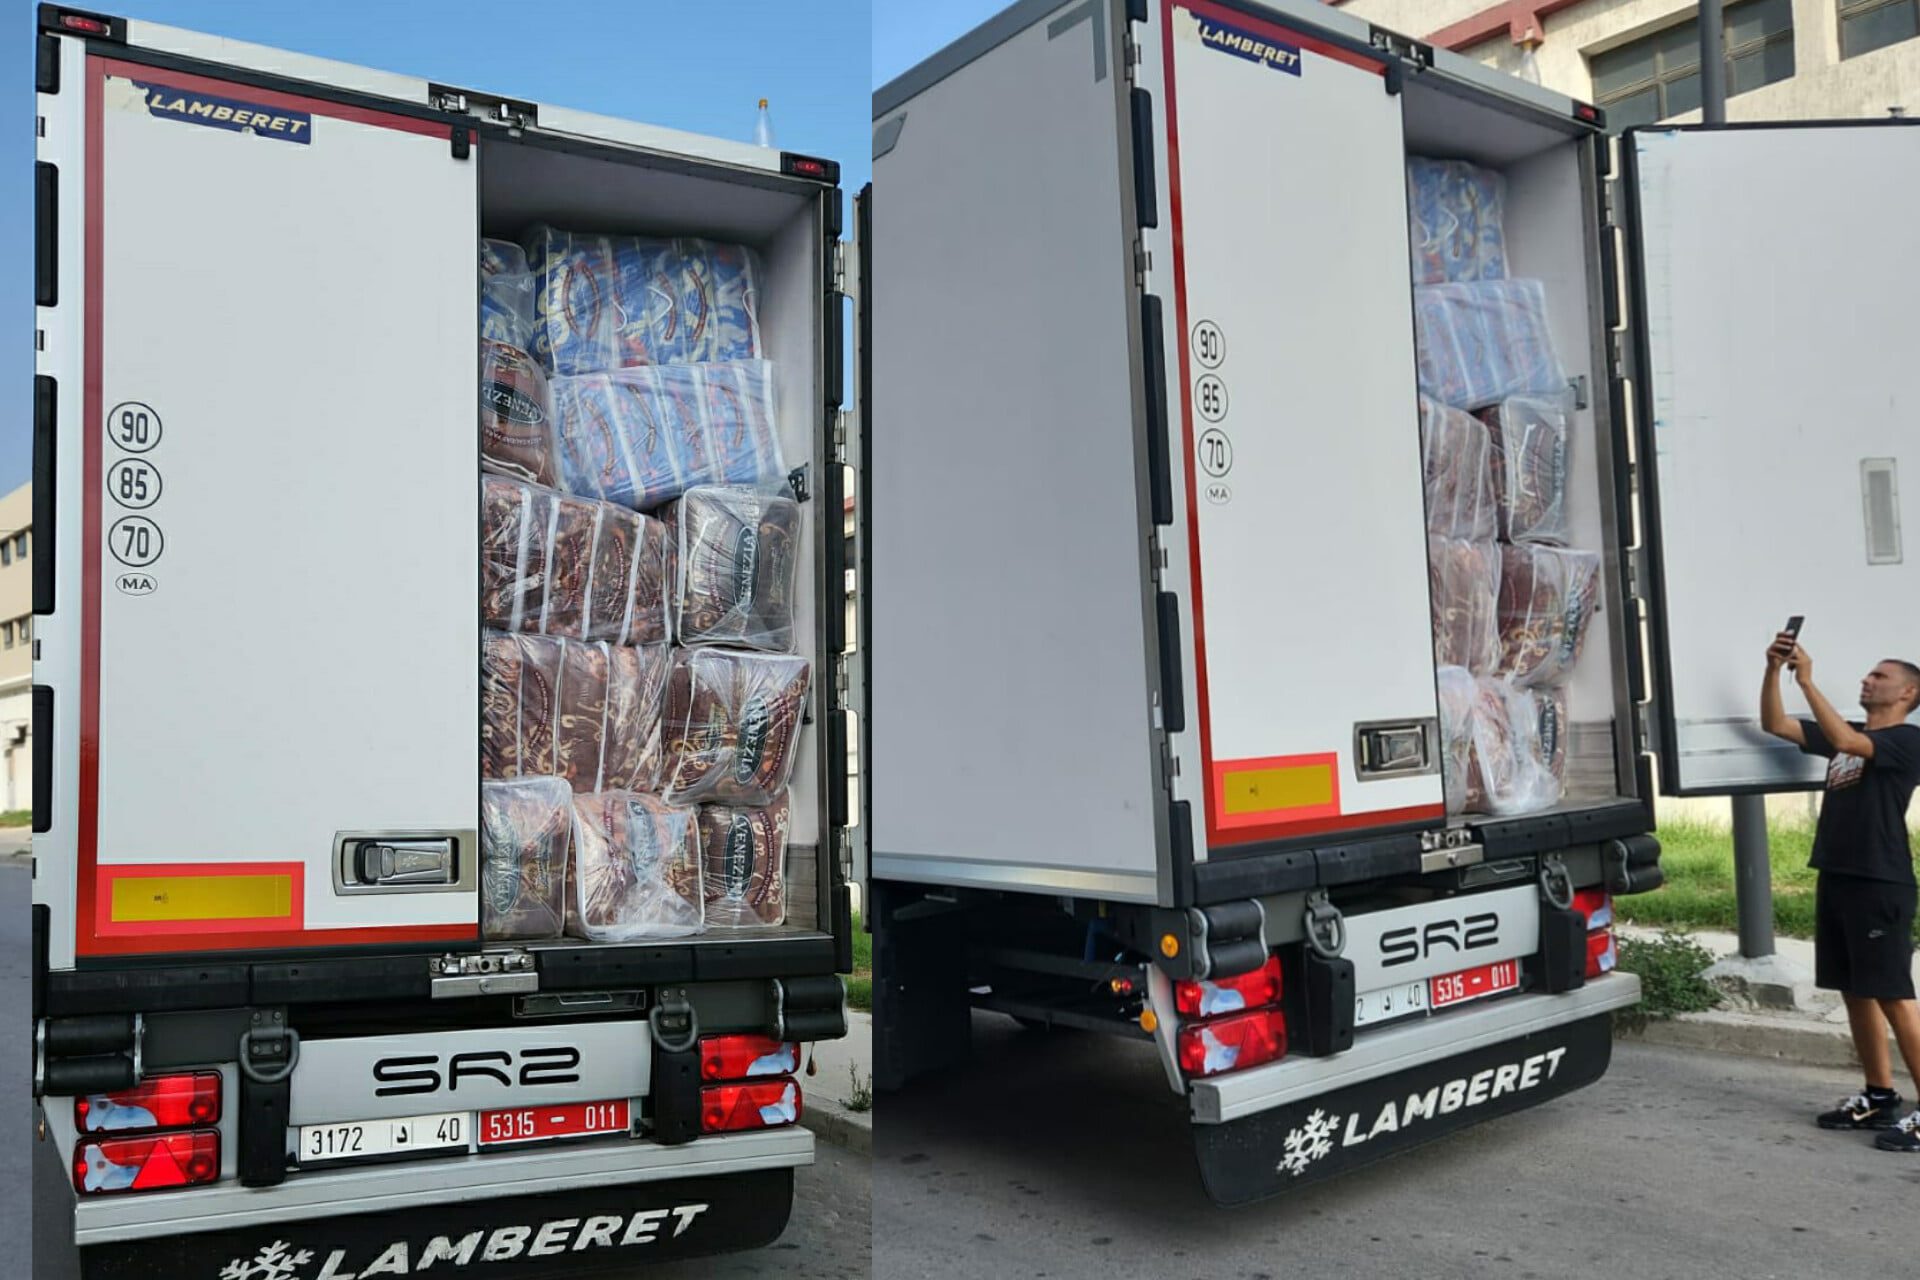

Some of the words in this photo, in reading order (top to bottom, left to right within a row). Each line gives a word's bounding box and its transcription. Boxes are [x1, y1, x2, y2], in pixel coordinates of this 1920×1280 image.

[1202, 25, 1298, 66] LAMBERET
[150, 93, 307, 134] LAMBERET
[1200, 329, 1217, 360] 90
[481, 382, 538, 420] VENEZI
[1203, 383, 1220, 414] 85
[121, 411, 149, 444] 90
[1207, 438, 1224, 468] 70
[121, 467, 148, 500] 85
[1209, 489, 1228, 498] MA
[122, 525, 150, 558] 70
[122, 579, 153, 590] MA
[1380, 912, 1499, 968] SR2
[1407, 984, 1421, 1008] 40
[1437, 976, 1464, 1002] 5315
[1491, 966, 1511, 988] 011
[373, 1047, 580, 1097] SR2
[1342, 1047, 1567, 1147] LAMBERET
[311, 1126, 363, 1156] 3172
[437, 1118, 461, 1142] 40
[490, 1112, 535, 1138] 5315
[585, 1105, 617, 1130] 011
[317, 1203, 709, 1280] LAMBERET
